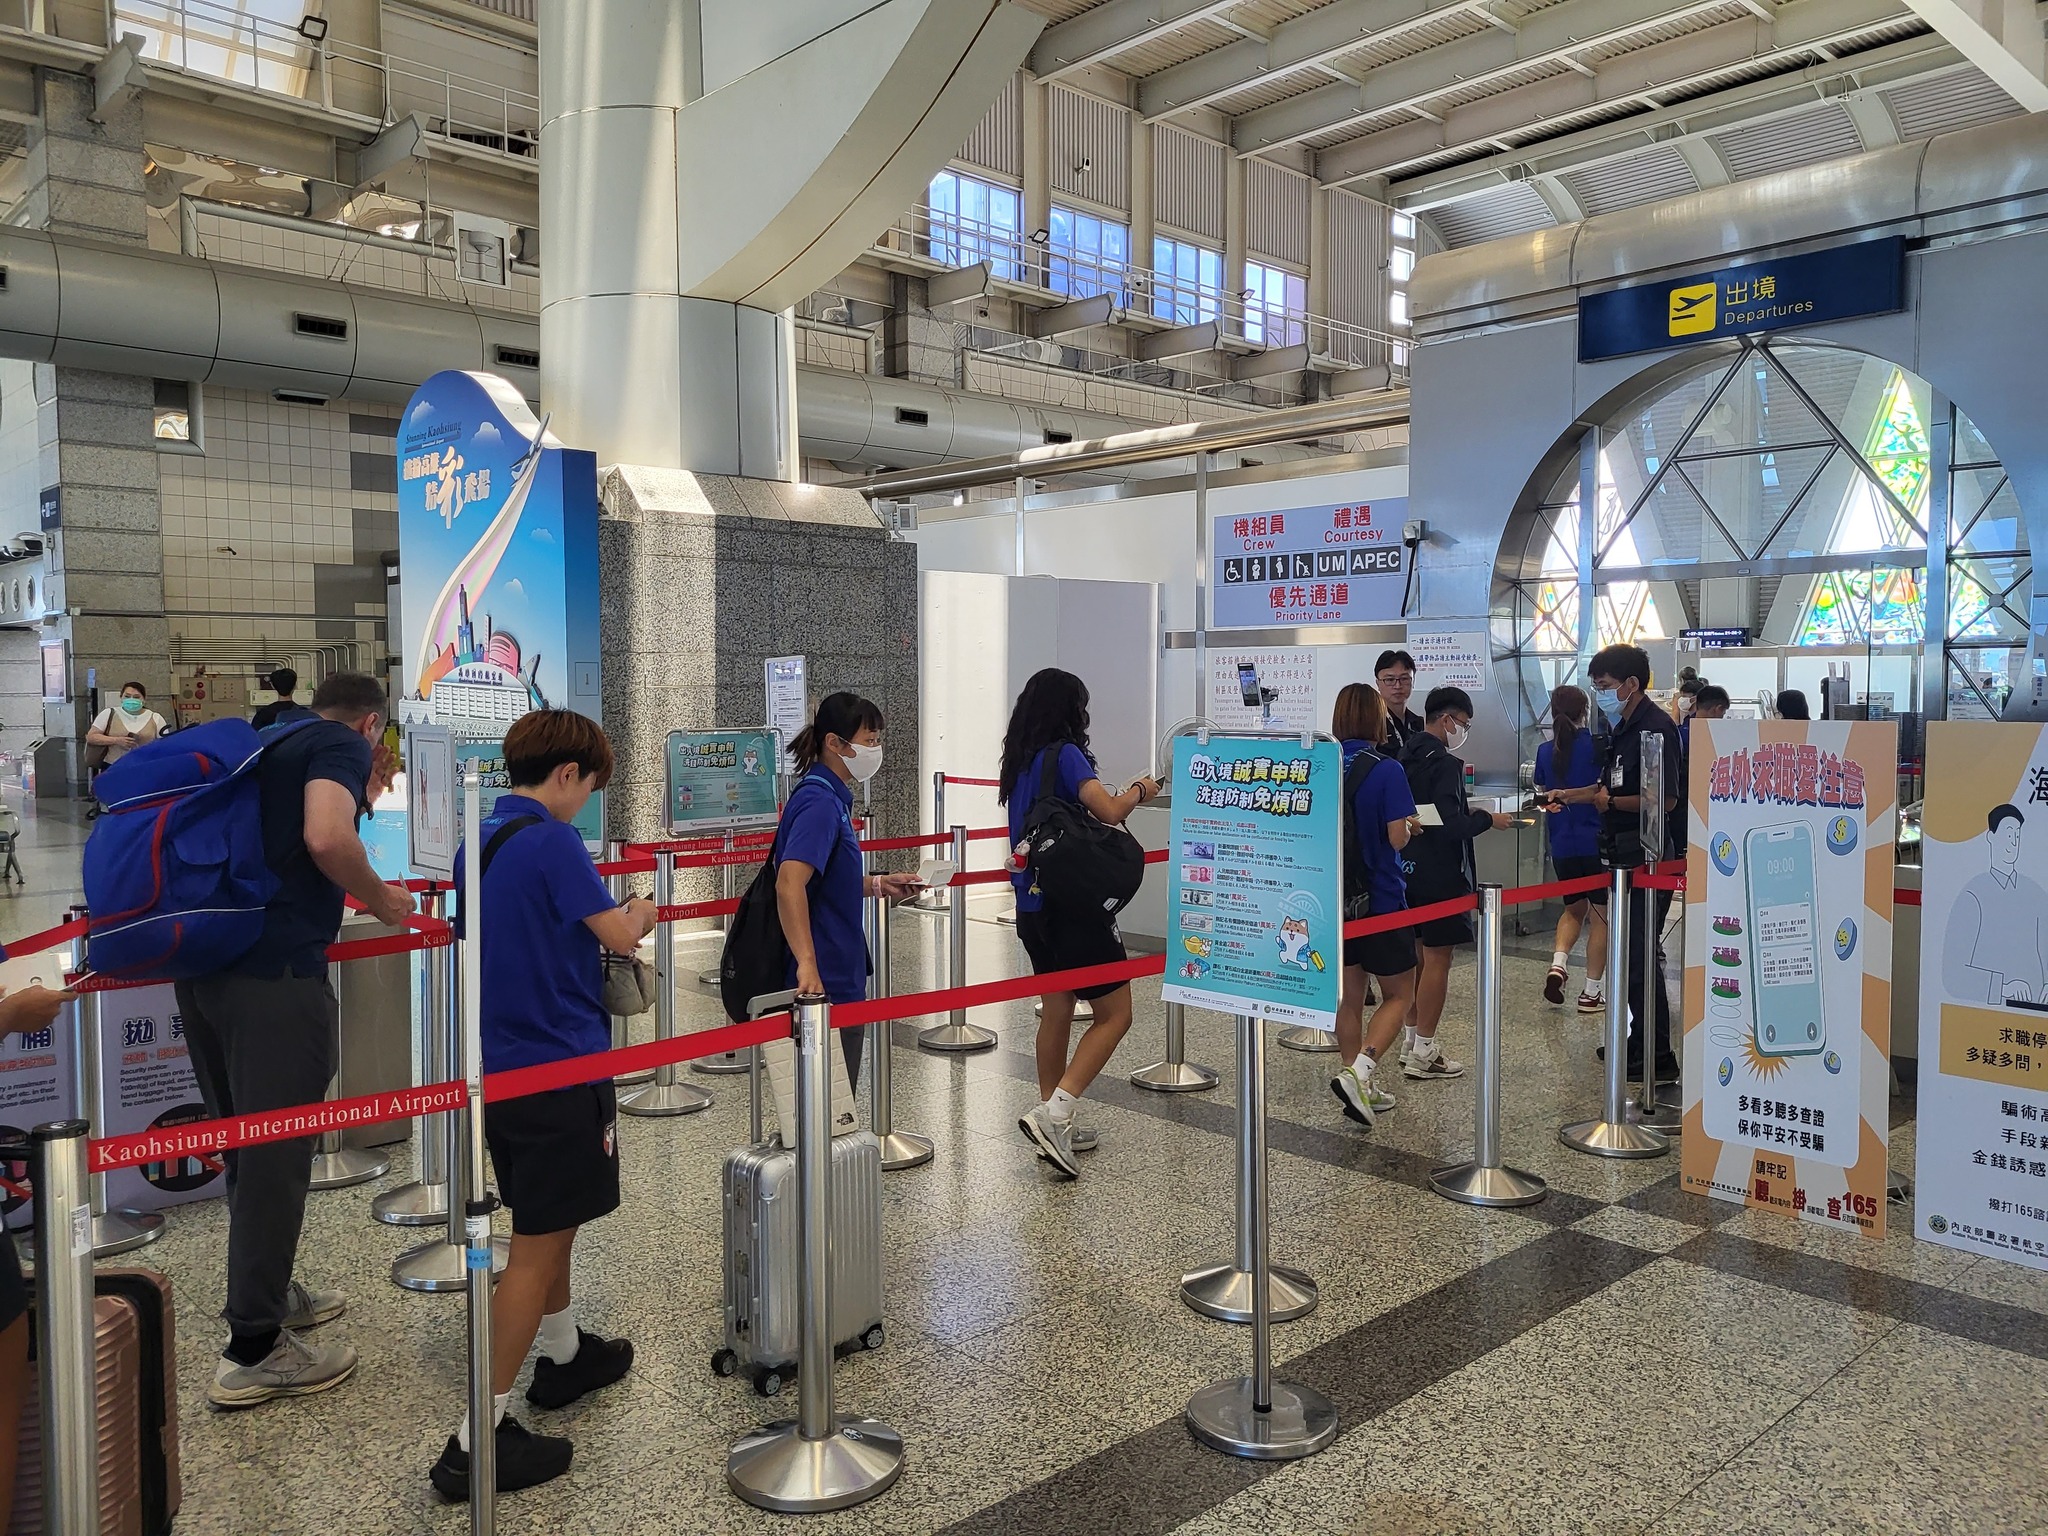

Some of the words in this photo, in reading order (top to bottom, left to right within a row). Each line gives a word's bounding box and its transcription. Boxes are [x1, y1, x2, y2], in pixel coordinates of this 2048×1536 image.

[1725, 275, 1776, 306] 出境
[1724, 300, 1814, 325] Departures
[428, 422, 462, 439] Kaohsiung
[1233, 514, 1286, 538] 機組員
[1333, 505, 1372, 529] 禮遇
[1243, 538, 1275, 551] Crew
[1324, 528, 1383, 544] Courtesy
[1318, 554, 1345, 572] UM
[1352, 551, 1399, 570] APEC
[1268, 582, 1349, 609] 優先通道
[1275, 611, 1313, 622] Priority
[1316, 609, 1341, 620] Lane
[1191, 757, 1310, 785] 出入境誠實申報
[1196, 785, 1311, 814] 洗錢防制免煩惱
[660, 841, 696, 851] Kaohsiung
[742, 836, 765, 846] Airport
[711, 854, 750, 864] Kaohsiung
[1767, 857, 1795, 875] 09:00
[663, 907, 699, 919] Airport
[1999, 1027, 2047, 1049] 求職停
[120, 1066, 147, 1076] Security
[148, 1064, 168, 1072] notice
[1966, 1046, 2042, 1071] 多疑多問，
[120, 1074, 159, 1084] Passengers
[172, 1069, 186, 1077] only
[1738, 1095, 1825, 1127] 多看多聽多查證
[99, 1129, 228, 1165] Kaohsiung
[239, 1106, 380, 1140] International
[388, 1088, 461, 1114] Airport
[1738, 1118, 1825, 1152] 保你平安不受騙
[1755, 1160, 1787, 1180] 請牢記
[1972, 1149, 2047, 1178] 金錢誘惑
[1792, 1188, 1807, 1211] 掛
